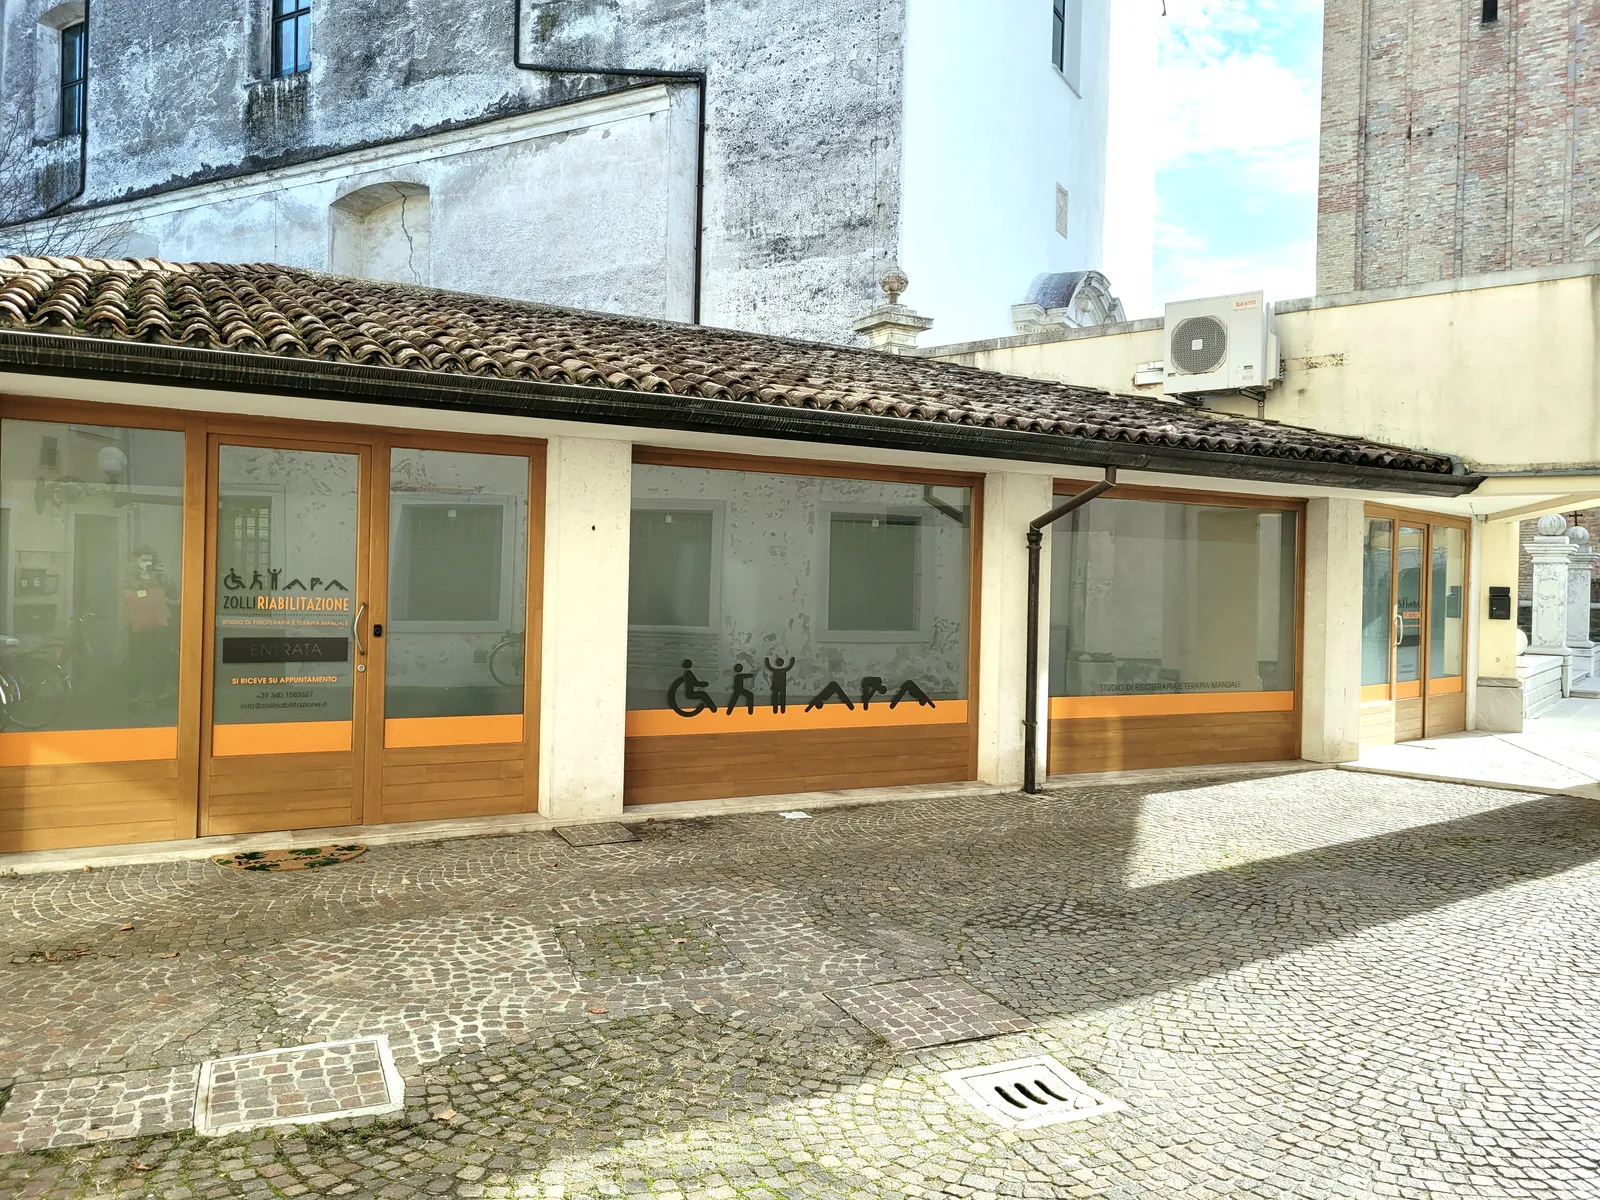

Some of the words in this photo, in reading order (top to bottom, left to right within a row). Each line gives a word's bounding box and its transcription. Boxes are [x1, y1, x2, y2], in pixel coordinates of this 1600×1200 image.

[251, 643, 322, 656] ENTRATA
[231, 677, 239, 685] SI
[240, 677, 267, 685] RICEVE
[279, 676, 338, 684] APPUNTAMENTO
[1100, 683, 1124, 691] STUDIO
[1126, 683, 1133, 691] DI
[1135, 683, 1177, 691] FISIOTERAPIA
[1178, 682, 1183, 690] E
[1184, 681, 1209, 690] TERAPIA
[1211, 680, 1241, 688] MANUALE
